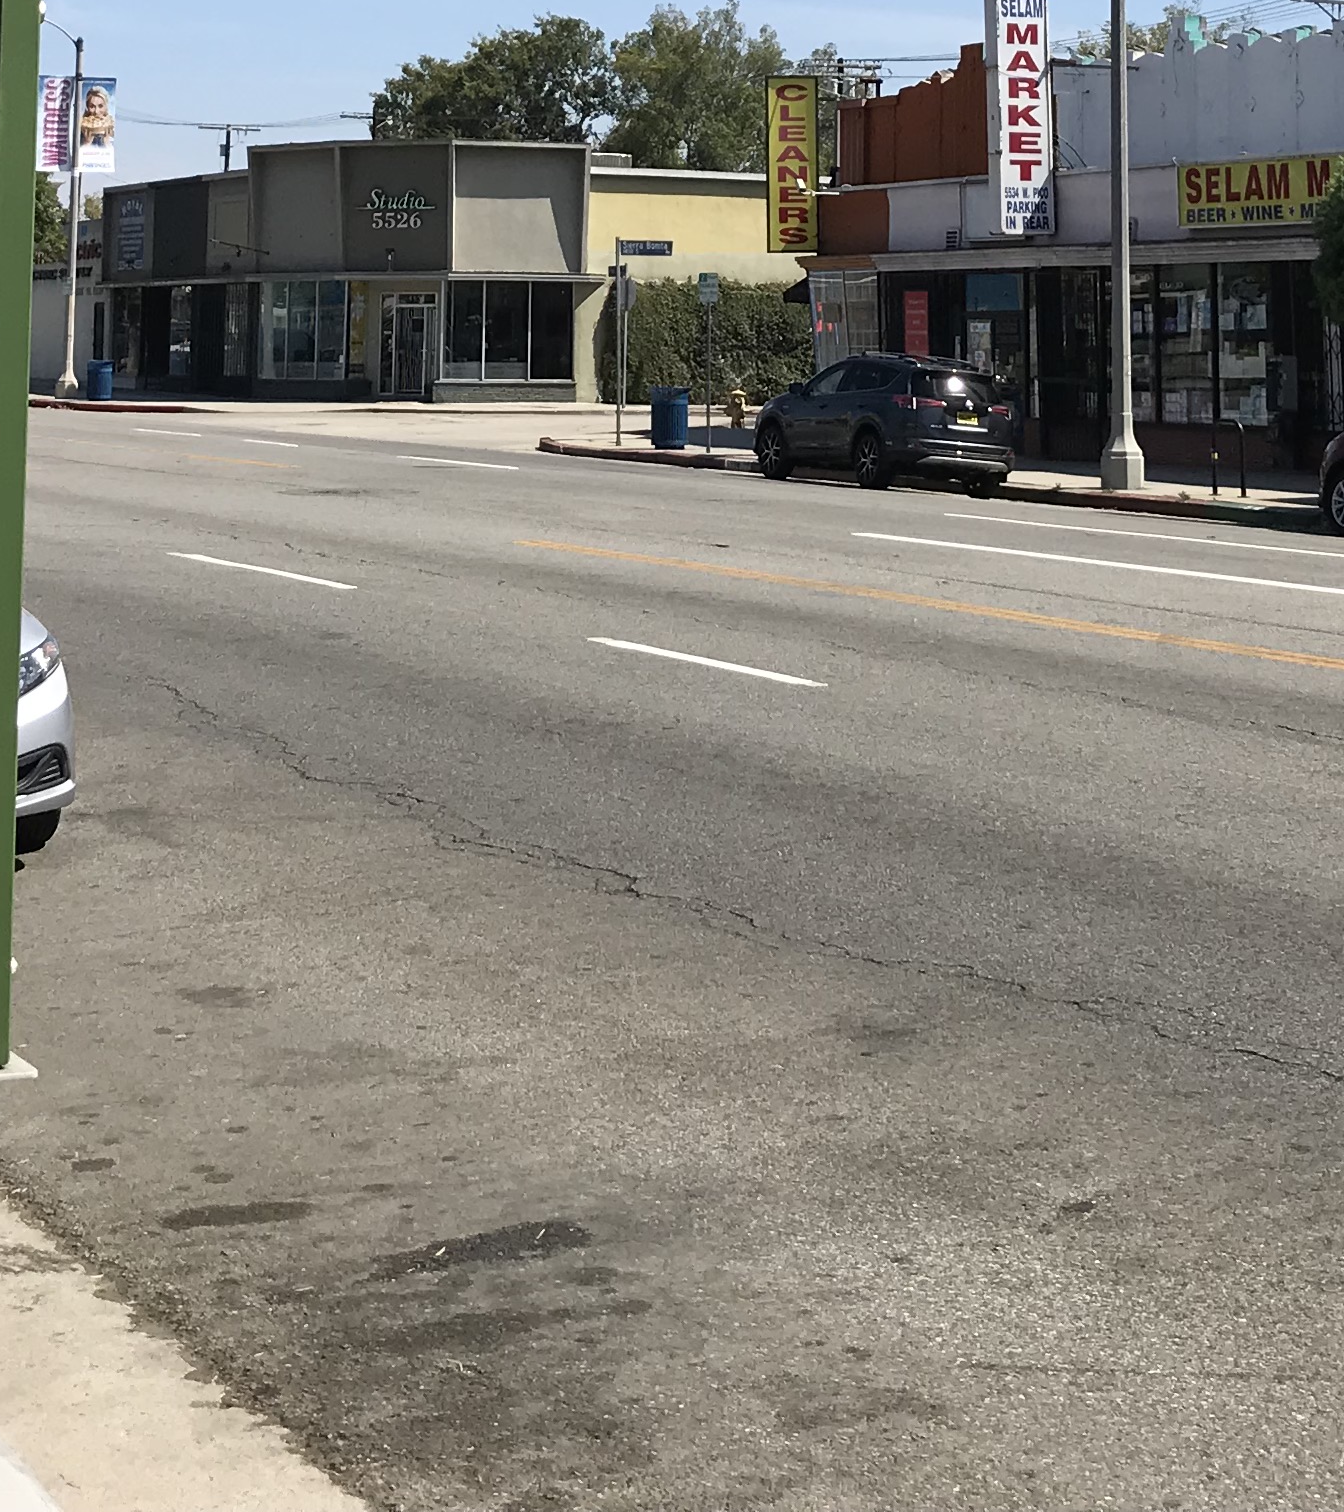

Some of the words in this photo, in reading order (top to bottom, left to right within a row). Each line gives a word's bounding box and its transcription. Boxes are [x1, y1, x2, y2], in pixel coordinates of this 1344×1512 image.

[1006, 23, 1043, 182] MARKET
[775, 84, 809, 245] CLEANERS
[1004, 186, 1019, 199] 5534
[1033, 186, 1049, 199] PICO
[1185, 163, 1291, 204] SELAM
[362, 188, 432, 210] Studio
[1006, 200, 1048, 214] PARKING
[371, 211, 423, 229] 5526
[1005, 215, 1016, 230] IN
[1022, 215, 1050, 230] REAR
[1186, 207, 1227, 224] BEER
[1241, 204, 1285, 222] WINE
